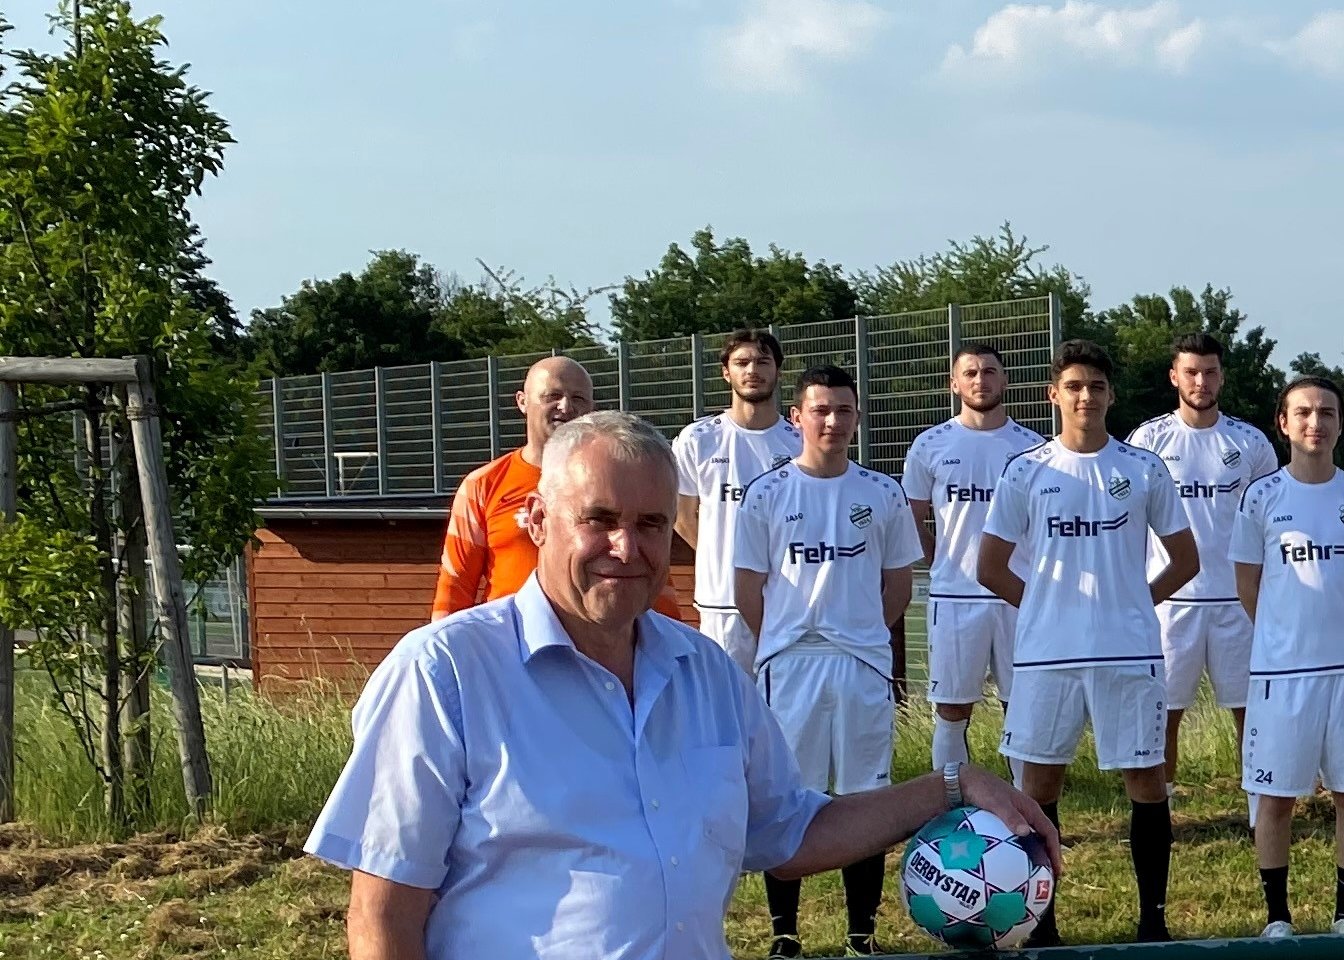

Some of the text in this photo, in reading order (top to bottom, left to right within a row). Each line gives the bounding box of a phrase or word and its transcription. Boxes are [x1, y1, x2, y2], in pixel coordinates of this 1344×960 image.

[946, 483, 994, 502] Fehr
[1040, 486, 1060, 495] JAKO
[1047, 515, 1101, 537] Fehr
[1272, 515, 1293, 523] JAKO
[1280, 540, 1333, 564] Fehr
[1255, 768, 1274, 785] 24
[910, 851, 981, 906] DERBYSTAR
